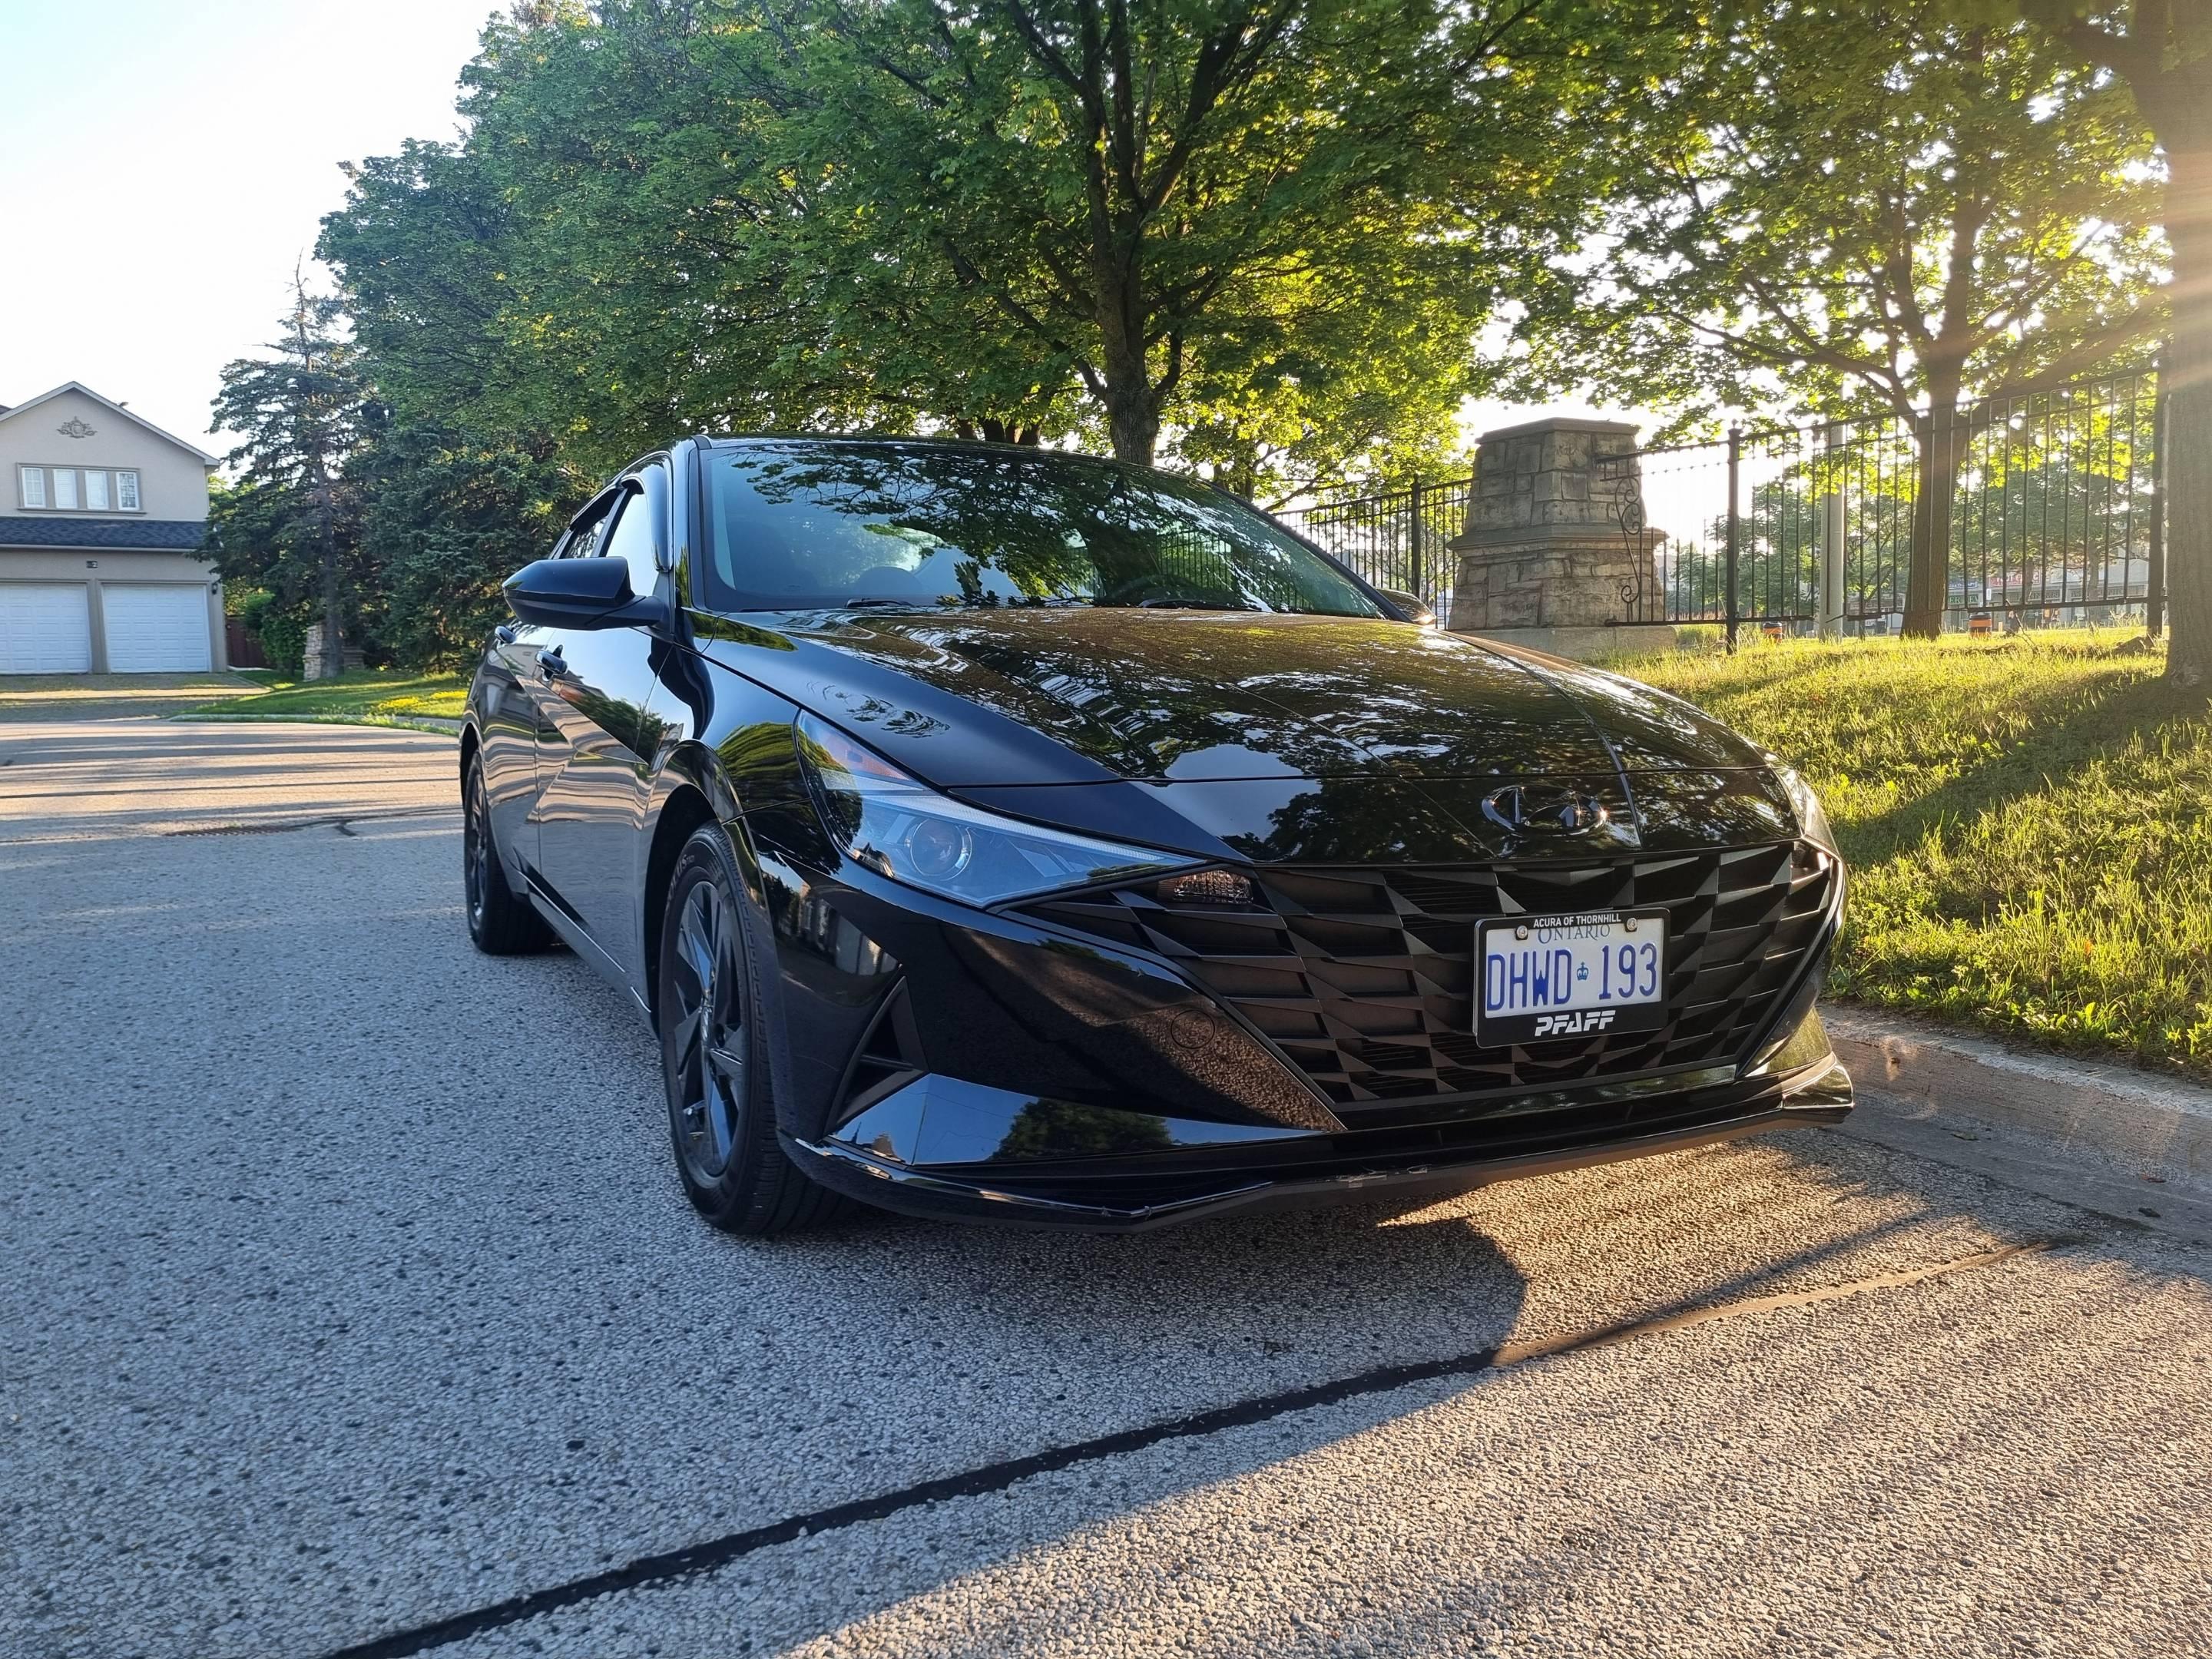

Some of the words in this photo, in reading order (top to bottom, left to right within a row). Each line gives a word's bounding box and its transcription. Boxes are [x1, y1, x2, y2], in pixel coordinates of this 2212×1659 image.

[1533, 916, 1561, 928] ACURA
[1563, 915, 1575, 926] OF
[1575, 912, 1621, 924] THORNHILL
[1538, 923, 1611, 944] ONTARIO
[1486, 949, 1572, 1011] DHWD
[1598, 942, 1657, 1001] 193
[1534, 1009, 1616, 1037] PFAFF
